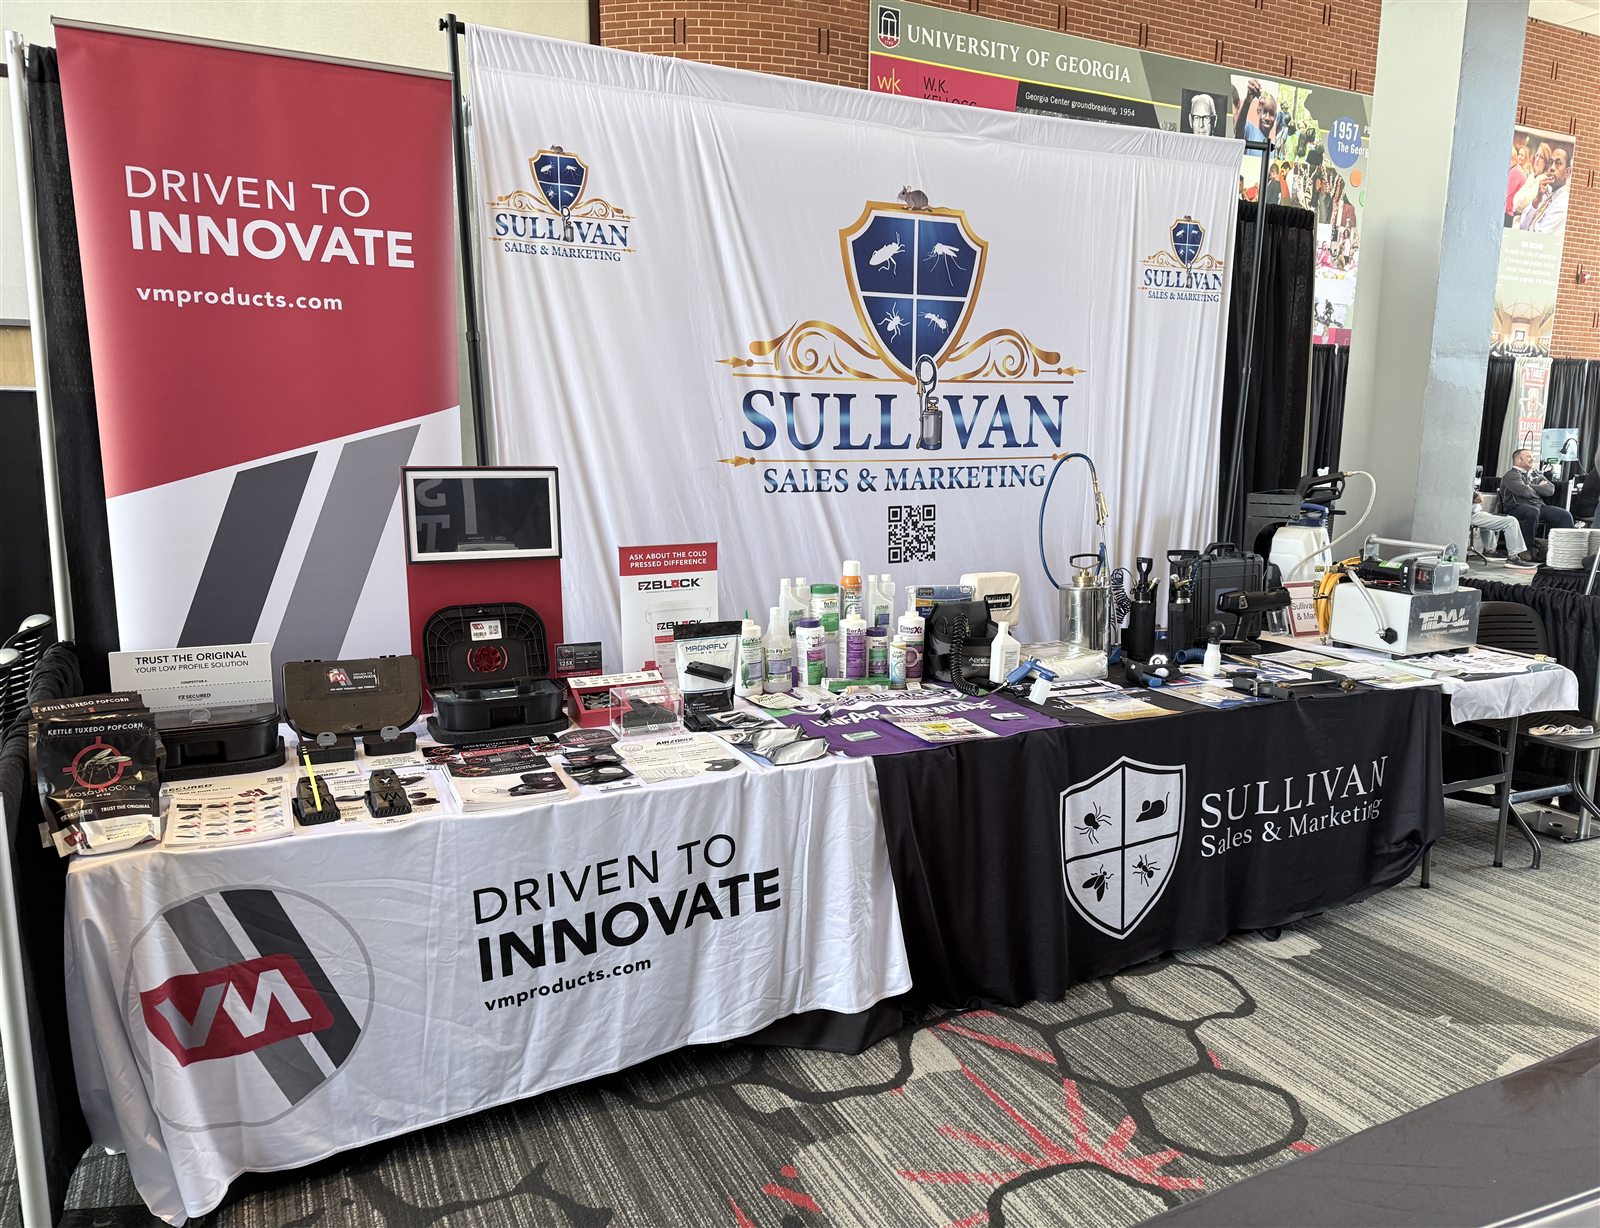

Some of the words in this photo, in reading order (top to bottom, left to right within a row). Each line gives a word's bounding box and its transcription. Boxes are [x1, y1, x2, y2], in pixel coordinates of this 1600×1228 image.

[907, 24, 1020, 63] UNIVERSITY
[1026, 49, 1050, 68] OF
[1055, 54, 1131, 83] GEORGIA
[923, 76, 949, 94] W.K.
[1025, 92, 1049, 103] Georgia
[1050, 95, 1070, 106] Center
[1071, 99, 1119, 115] groundbreaking,
[1120, 107, 1136, 117] 1954
[1333, 120, 1359, 141] 1957
[1337, 141, 1349, 153] The
[124, 165, 295, 211] DRIVEN
[311, 183, 370, 217] TO
[129, 209, 415, 269] INNOVATE
[504, 241, 537, 255] SALES
[540, 245, 549, 256] &
[551, 245, 621, 262] MARKETING
[136, 286, 343, 310] vmproducts.com
[1147, 290, 1168, 300] SALES
[1169, 291, 1176, 300] &
[763, 467, 849, 494] SALES
[856, 467, 878, 493] &
[884, 464, 1046, 492] MARKETING
[663, 558, 707, 567] DIFFERENCE
[1291, 602, 1315, 611] Sulliva
[1296, 612, 1303, 620] &
[135, 655, 170, 665] TRUST
[172, 653, 193, 663] THE
[196, 650, 247, 661] ORIGINAL
[685, 643, 728, 652] MAGNAFLY
[134, 666, 157, 674] YOUR
[158, 664, 177, 672] LOW
[178, 662, 210, 671] PROFILE
[211, 659, 249, 669] SOLUTION
[47, 727, 73, 736] KETTLE
[74, 725, 105, 734] TUXEDO
[107, 722, 144, 731] POPCORN
[1200, 755, 1389, 829] SULLIVAN
[100, 805, 116, 813] TRUST
[1200, 827, 1253, 858] Sales
[1261, 821, 1283, 842] &
[472, 850, 659, 925] DRIVEN
[677, 833, 736, 875] TO
[478, 867, 781, 983] INNOVATE
[484, 959, 652, 1012] vmproducts.com
[153, 968, 313, 1050] VM
